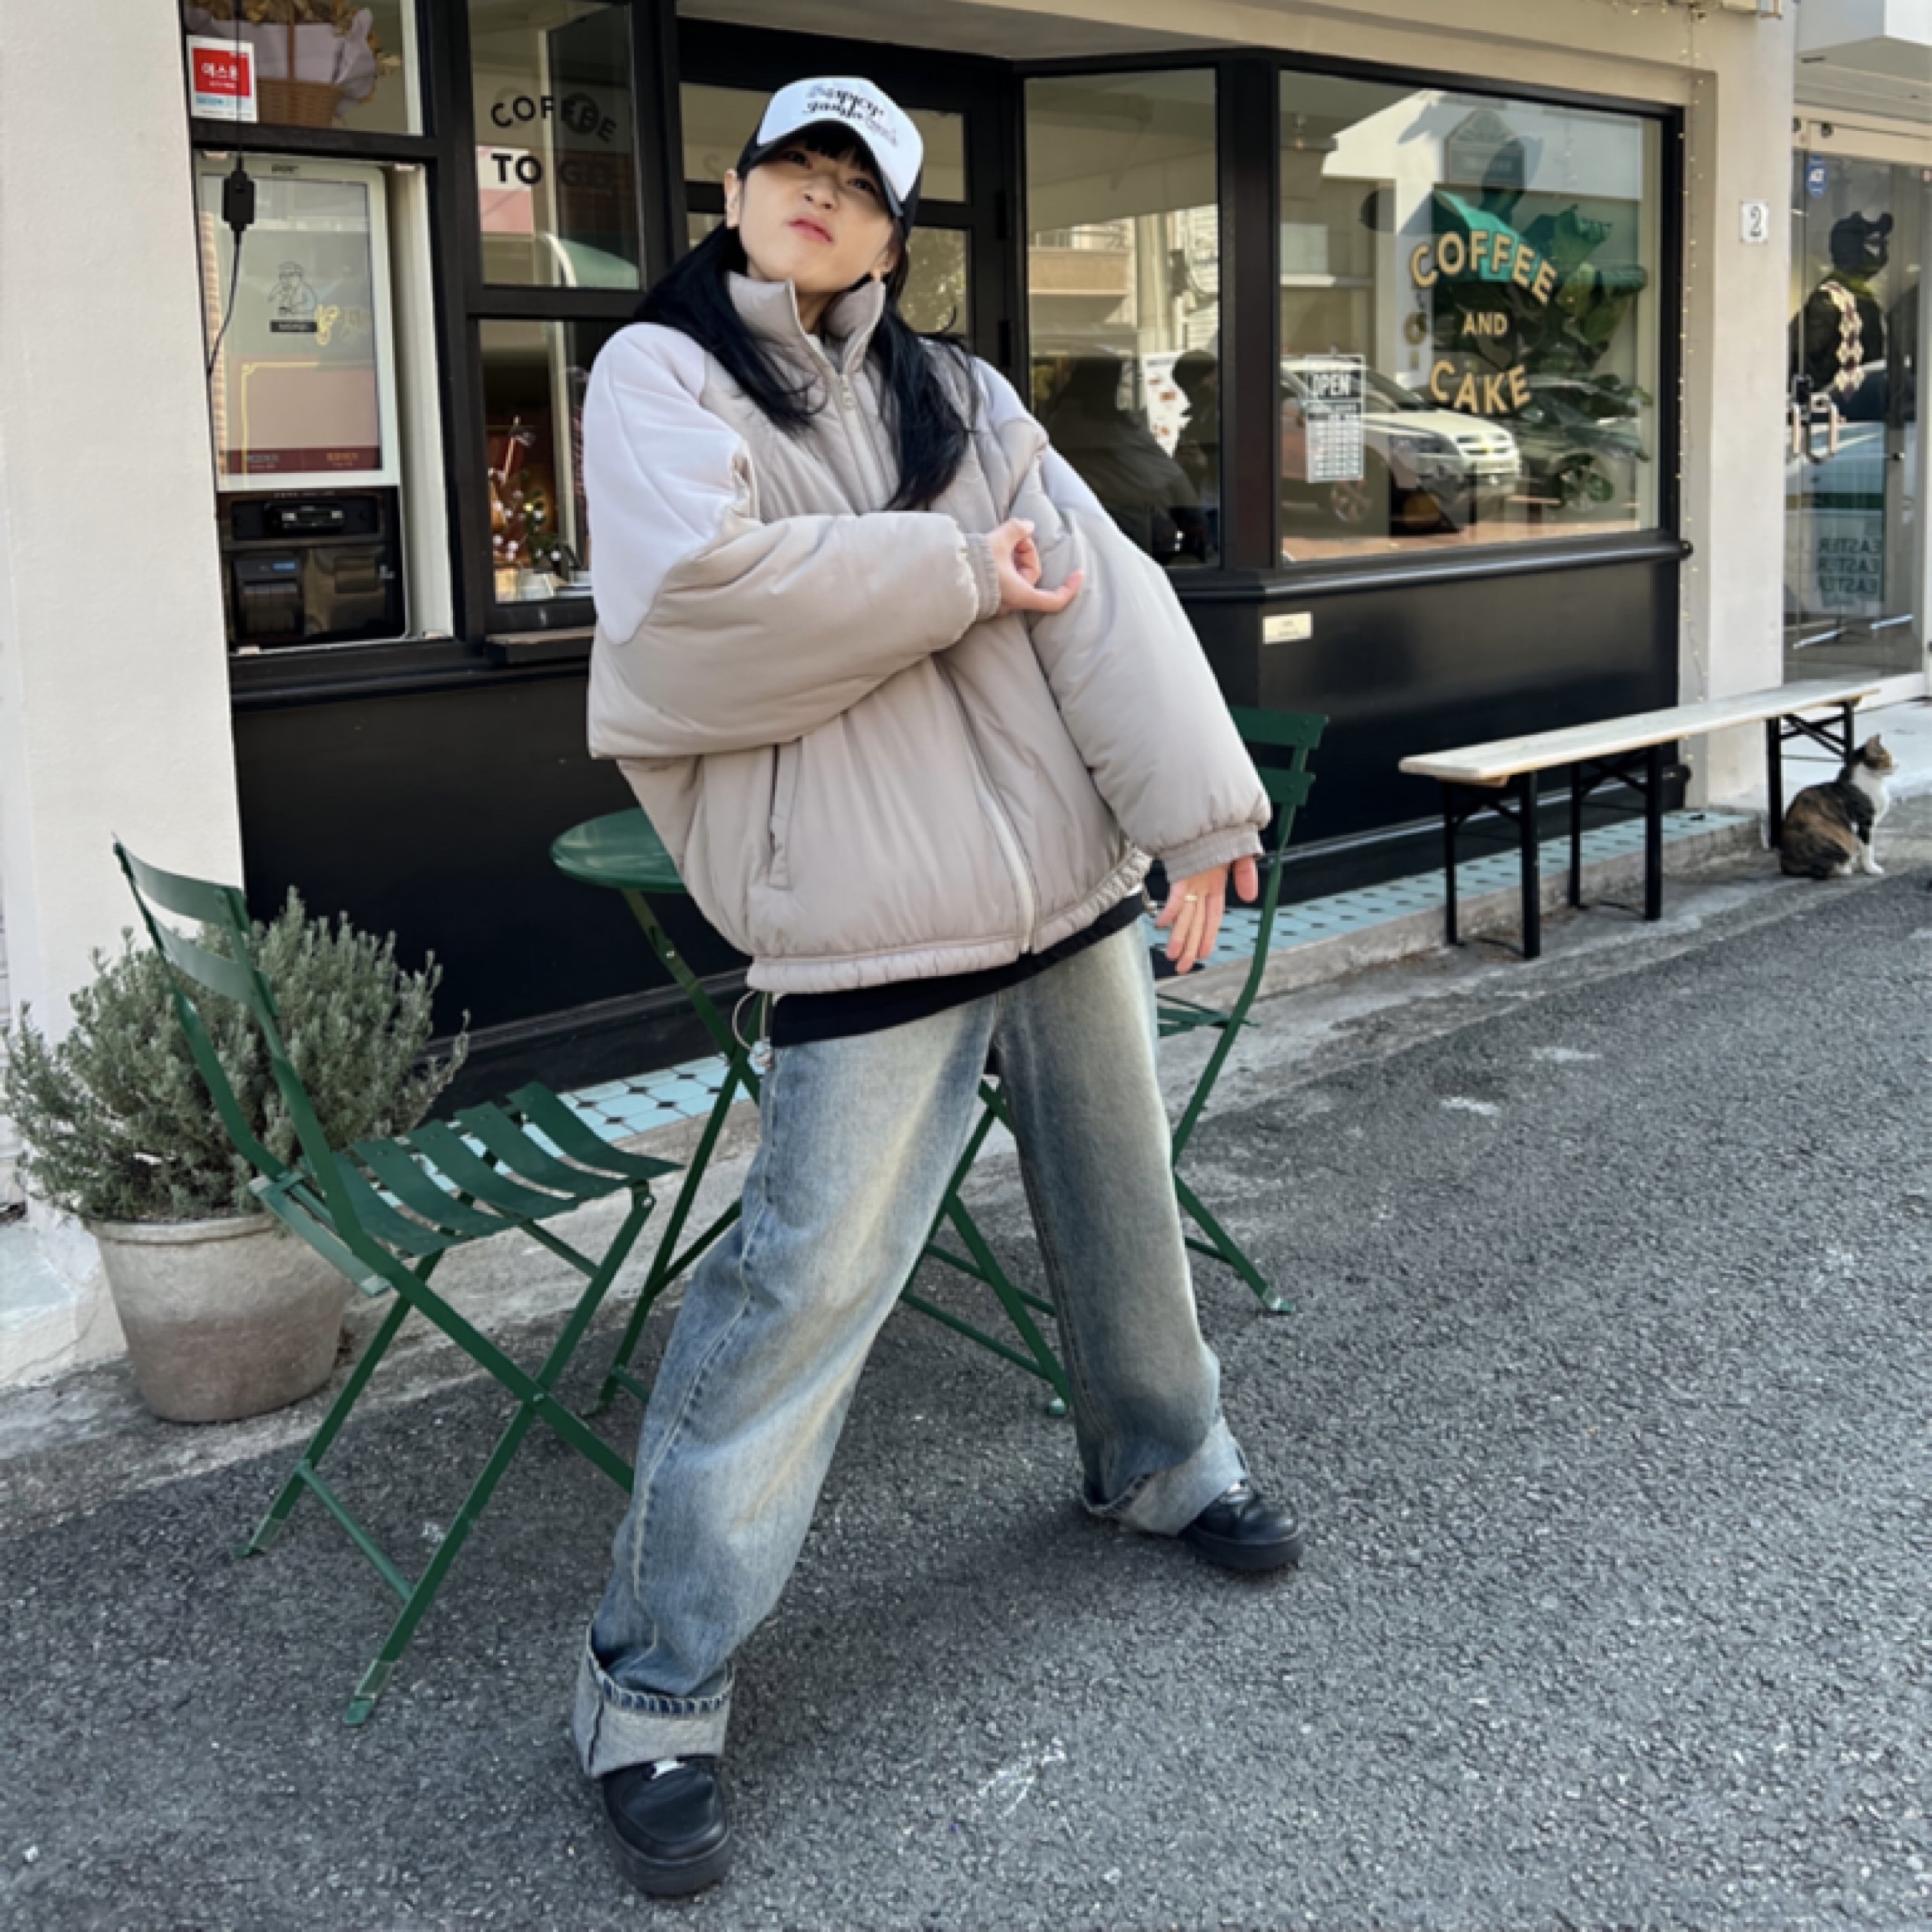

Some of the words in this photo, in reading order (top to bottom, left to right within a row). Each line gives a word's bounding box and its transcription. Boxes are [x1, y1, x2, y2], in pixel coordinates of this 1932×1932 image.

[490, 95, 617, 143] COFFEE
[491, 153, 543, 185] TO
[1750, 205, 1762, 237] 2
[1410, 230, 1558, 307] COFFEE
[1461, 310, 1508, 337] AND
[1430, 359, 1532, 414] CAKE
